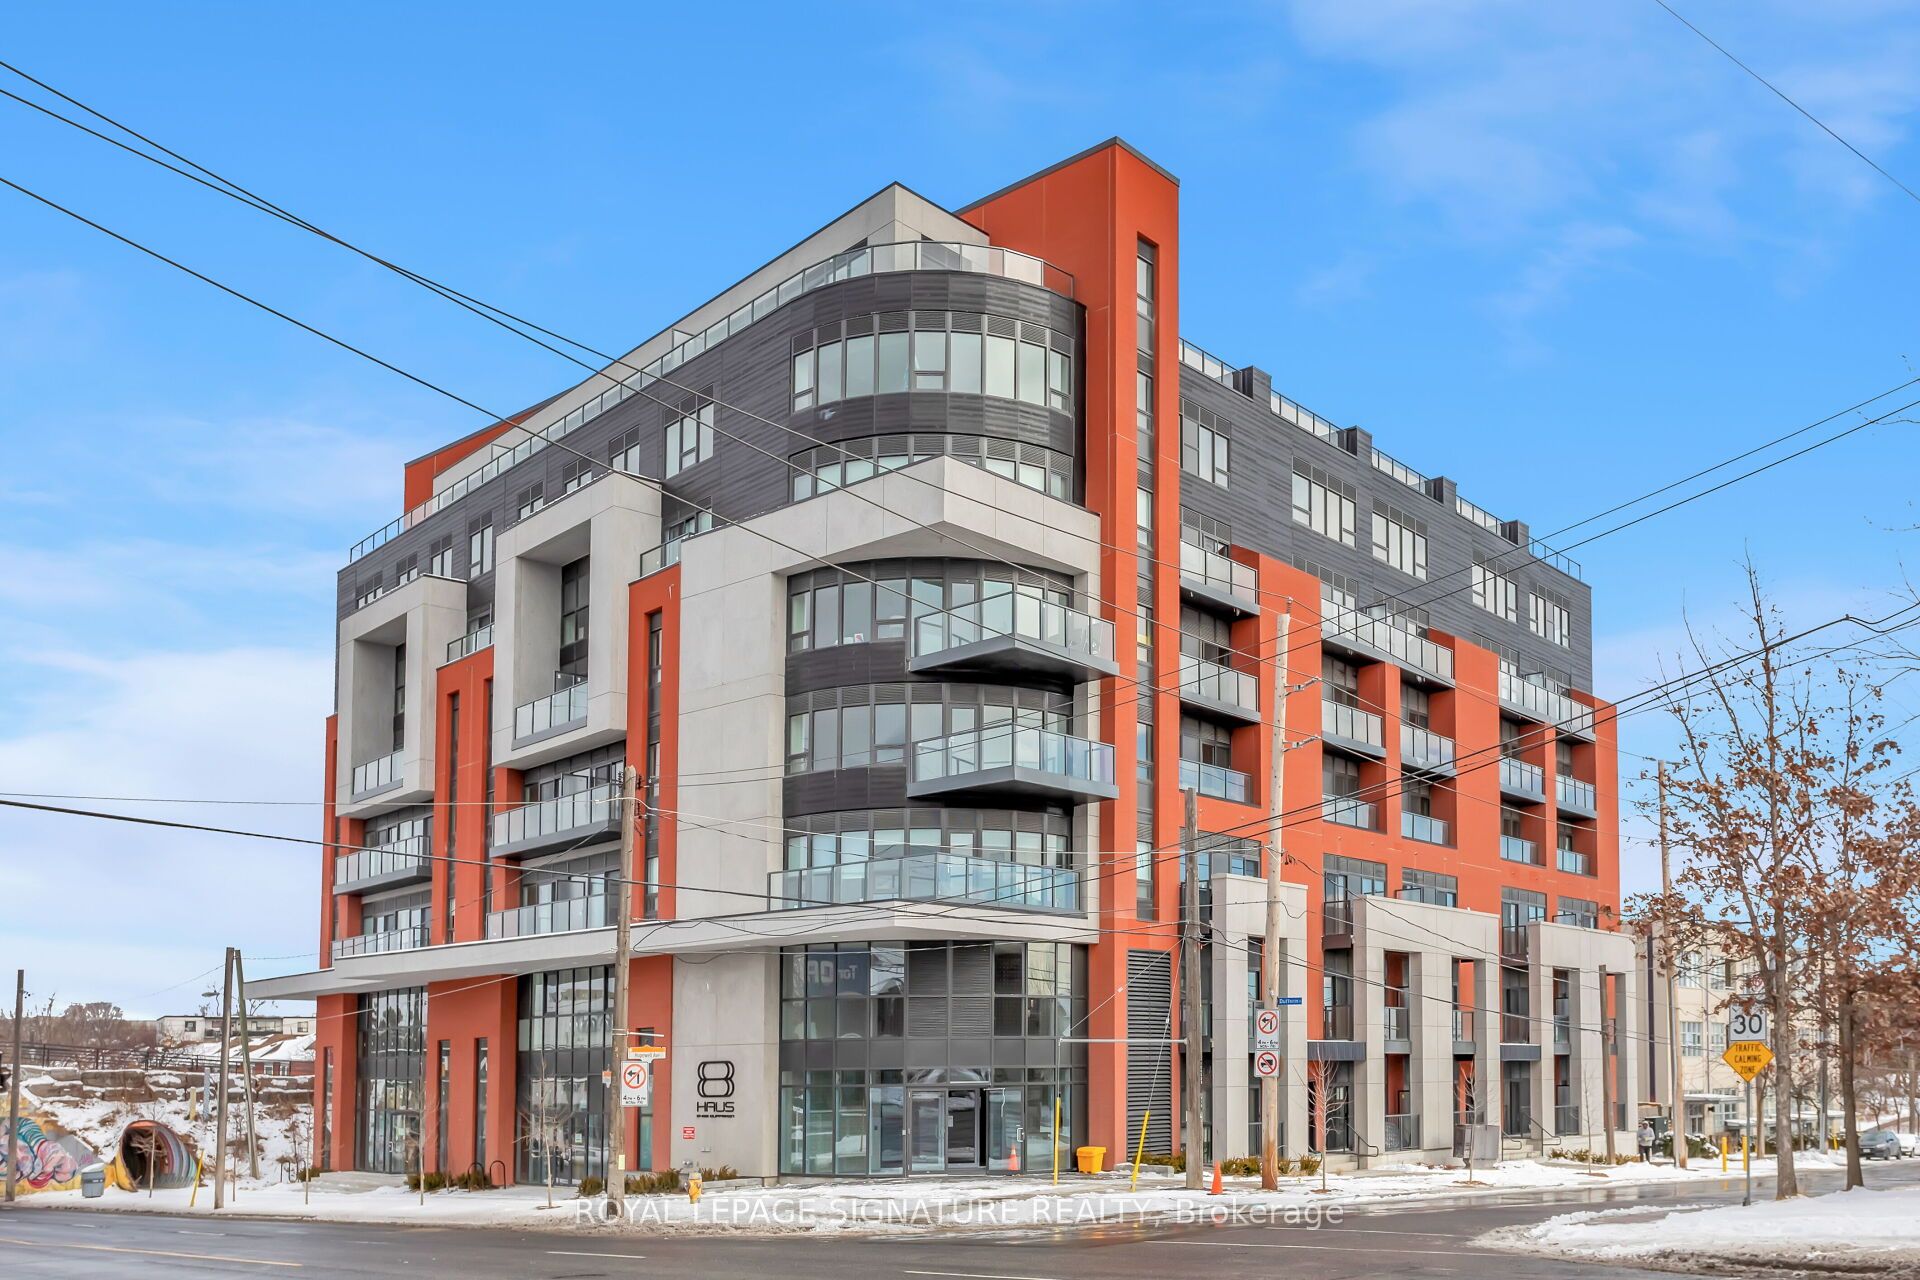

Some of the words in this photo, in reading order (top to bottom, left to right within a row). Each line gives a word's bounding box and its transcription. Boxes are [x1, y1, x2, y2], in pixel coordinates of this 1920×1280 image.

[1734, 1014, 1762, 1034] 30
[1735, 1044, 1761, 1052] TRAFFIC
[1734, 1055, 1762, 1063] CALMING
[1740, 1065, 1755, 1074] ZONE
[696, 1101, 735, 1113] HAUS
